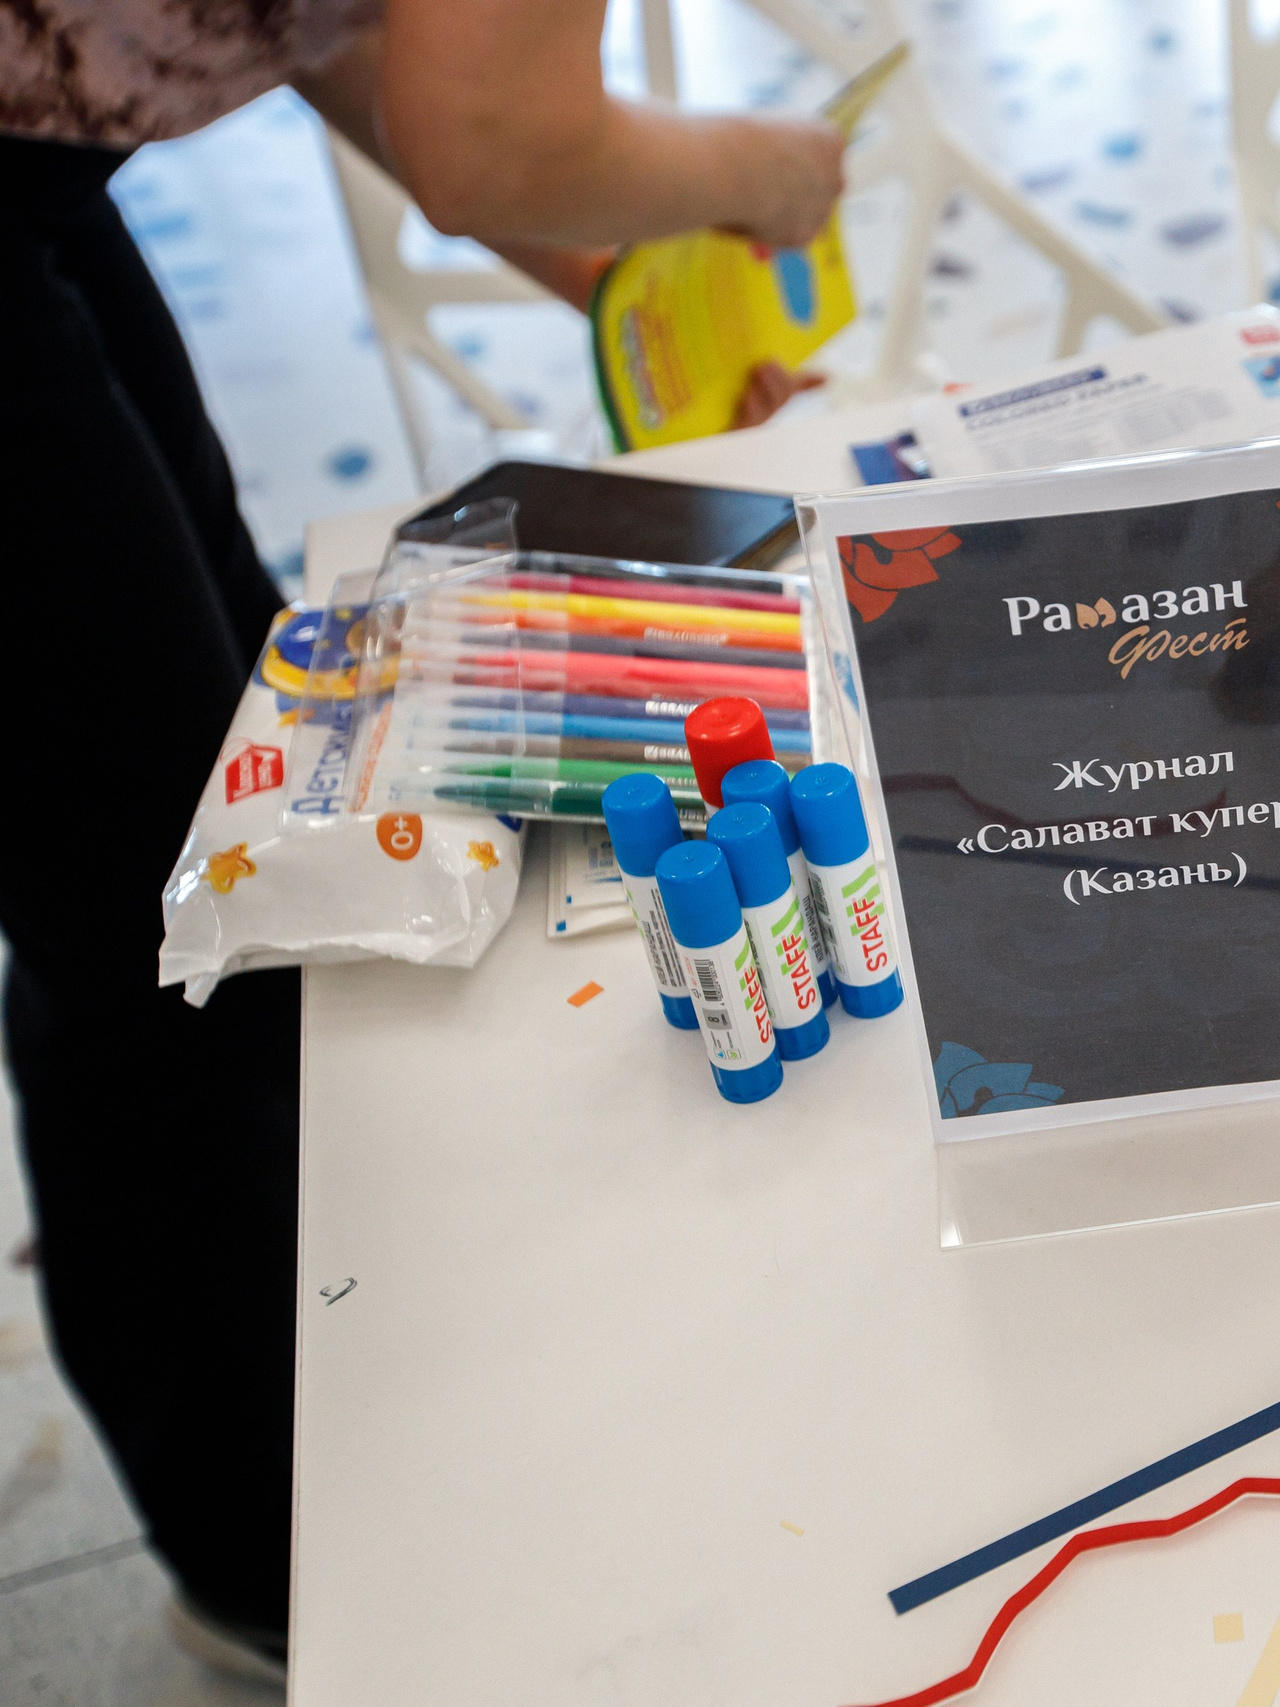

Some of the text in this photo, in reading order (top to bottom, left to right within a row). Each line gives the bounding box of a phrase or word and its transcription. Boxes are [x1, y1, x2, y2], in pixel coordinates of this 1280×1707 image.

[1051, 751, 1235, 792] Журнал
[956, 814, 1158, 855] «Салават
[1062, 852, 1248, 905] (Казань)
[852, 897, 888, 973] STAFF
[781, 934, 816, 1010] STAFF
[743, 966, 772, 1044] STAFF
